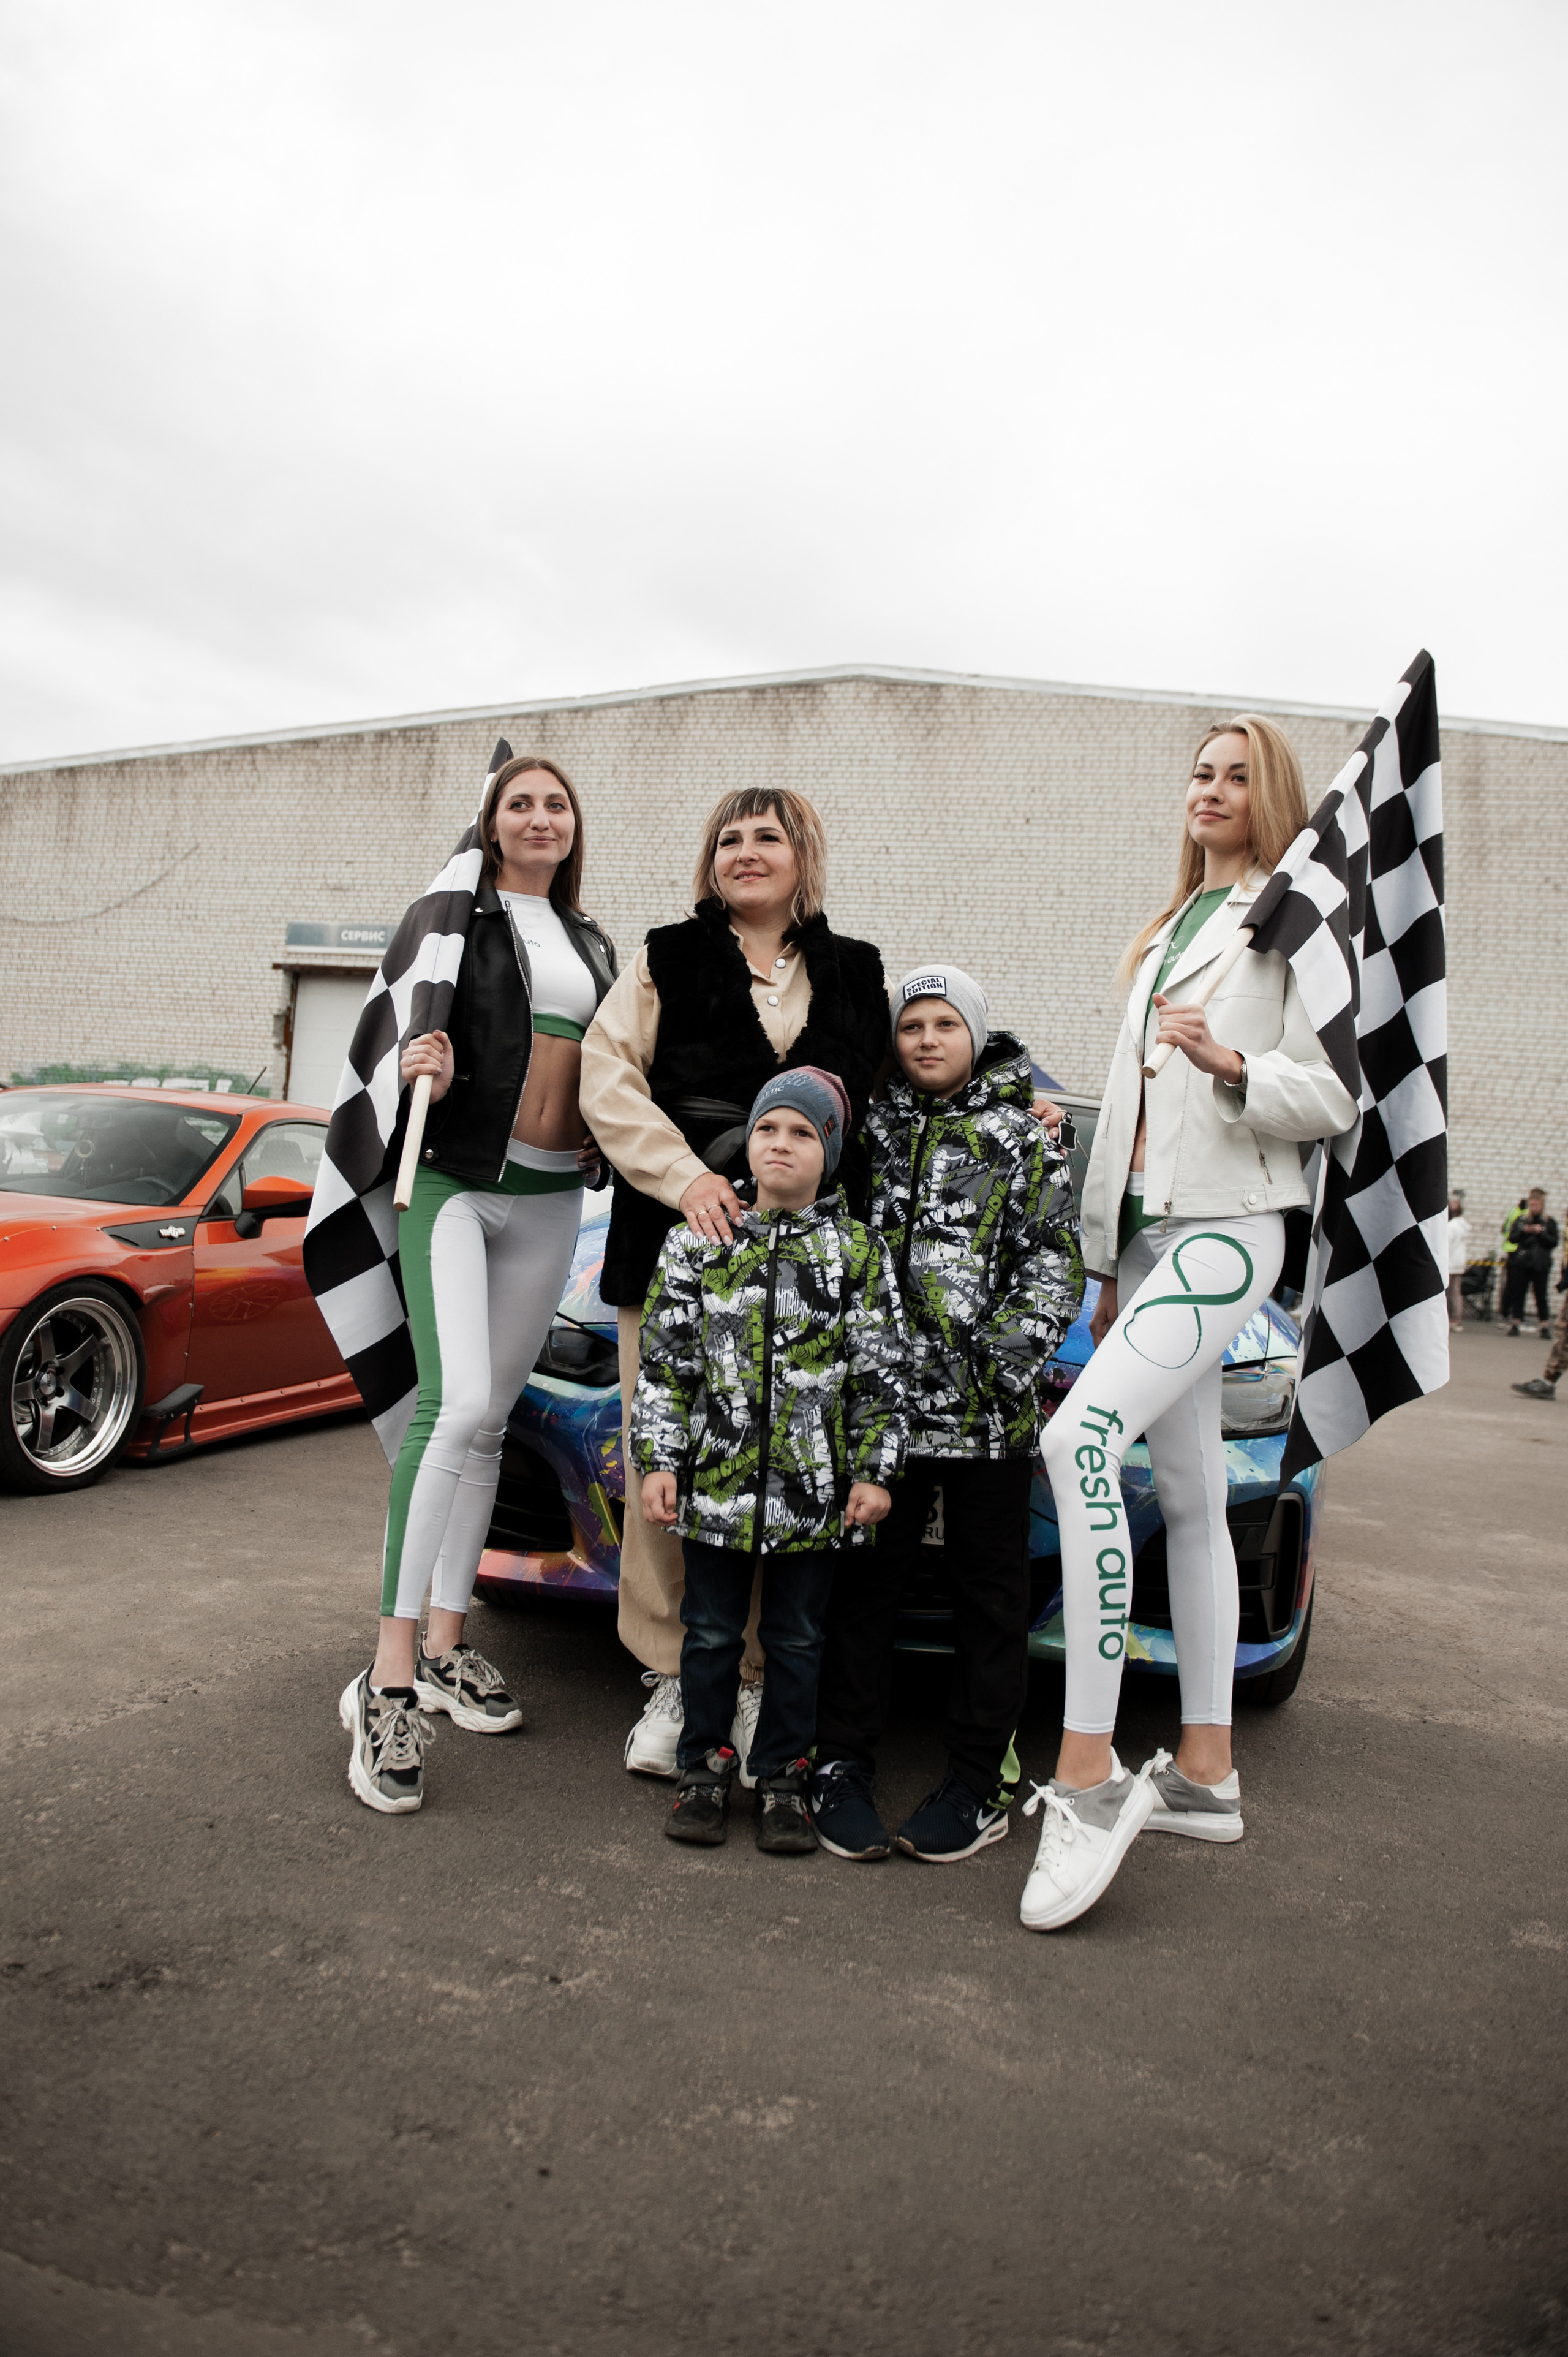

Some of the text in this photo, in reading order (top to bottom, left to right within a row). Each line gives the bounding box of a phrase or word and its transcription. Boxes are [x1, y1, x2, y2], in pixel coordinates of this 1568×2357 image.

[341, 929, 386, 942] СЕРВИС
[907, 978, 940, 993] SPECIAL
[908, 983, 943, 996] EDITION
[892, 1202, 908, 1224] SKATE
[814, 1267, 824, 1288] BORN
[715, 1396, 730, 1415] BORN
[802, 1474, 813, 1494] BORN
[1074, 1405, 1129, 1660] fresh auto
